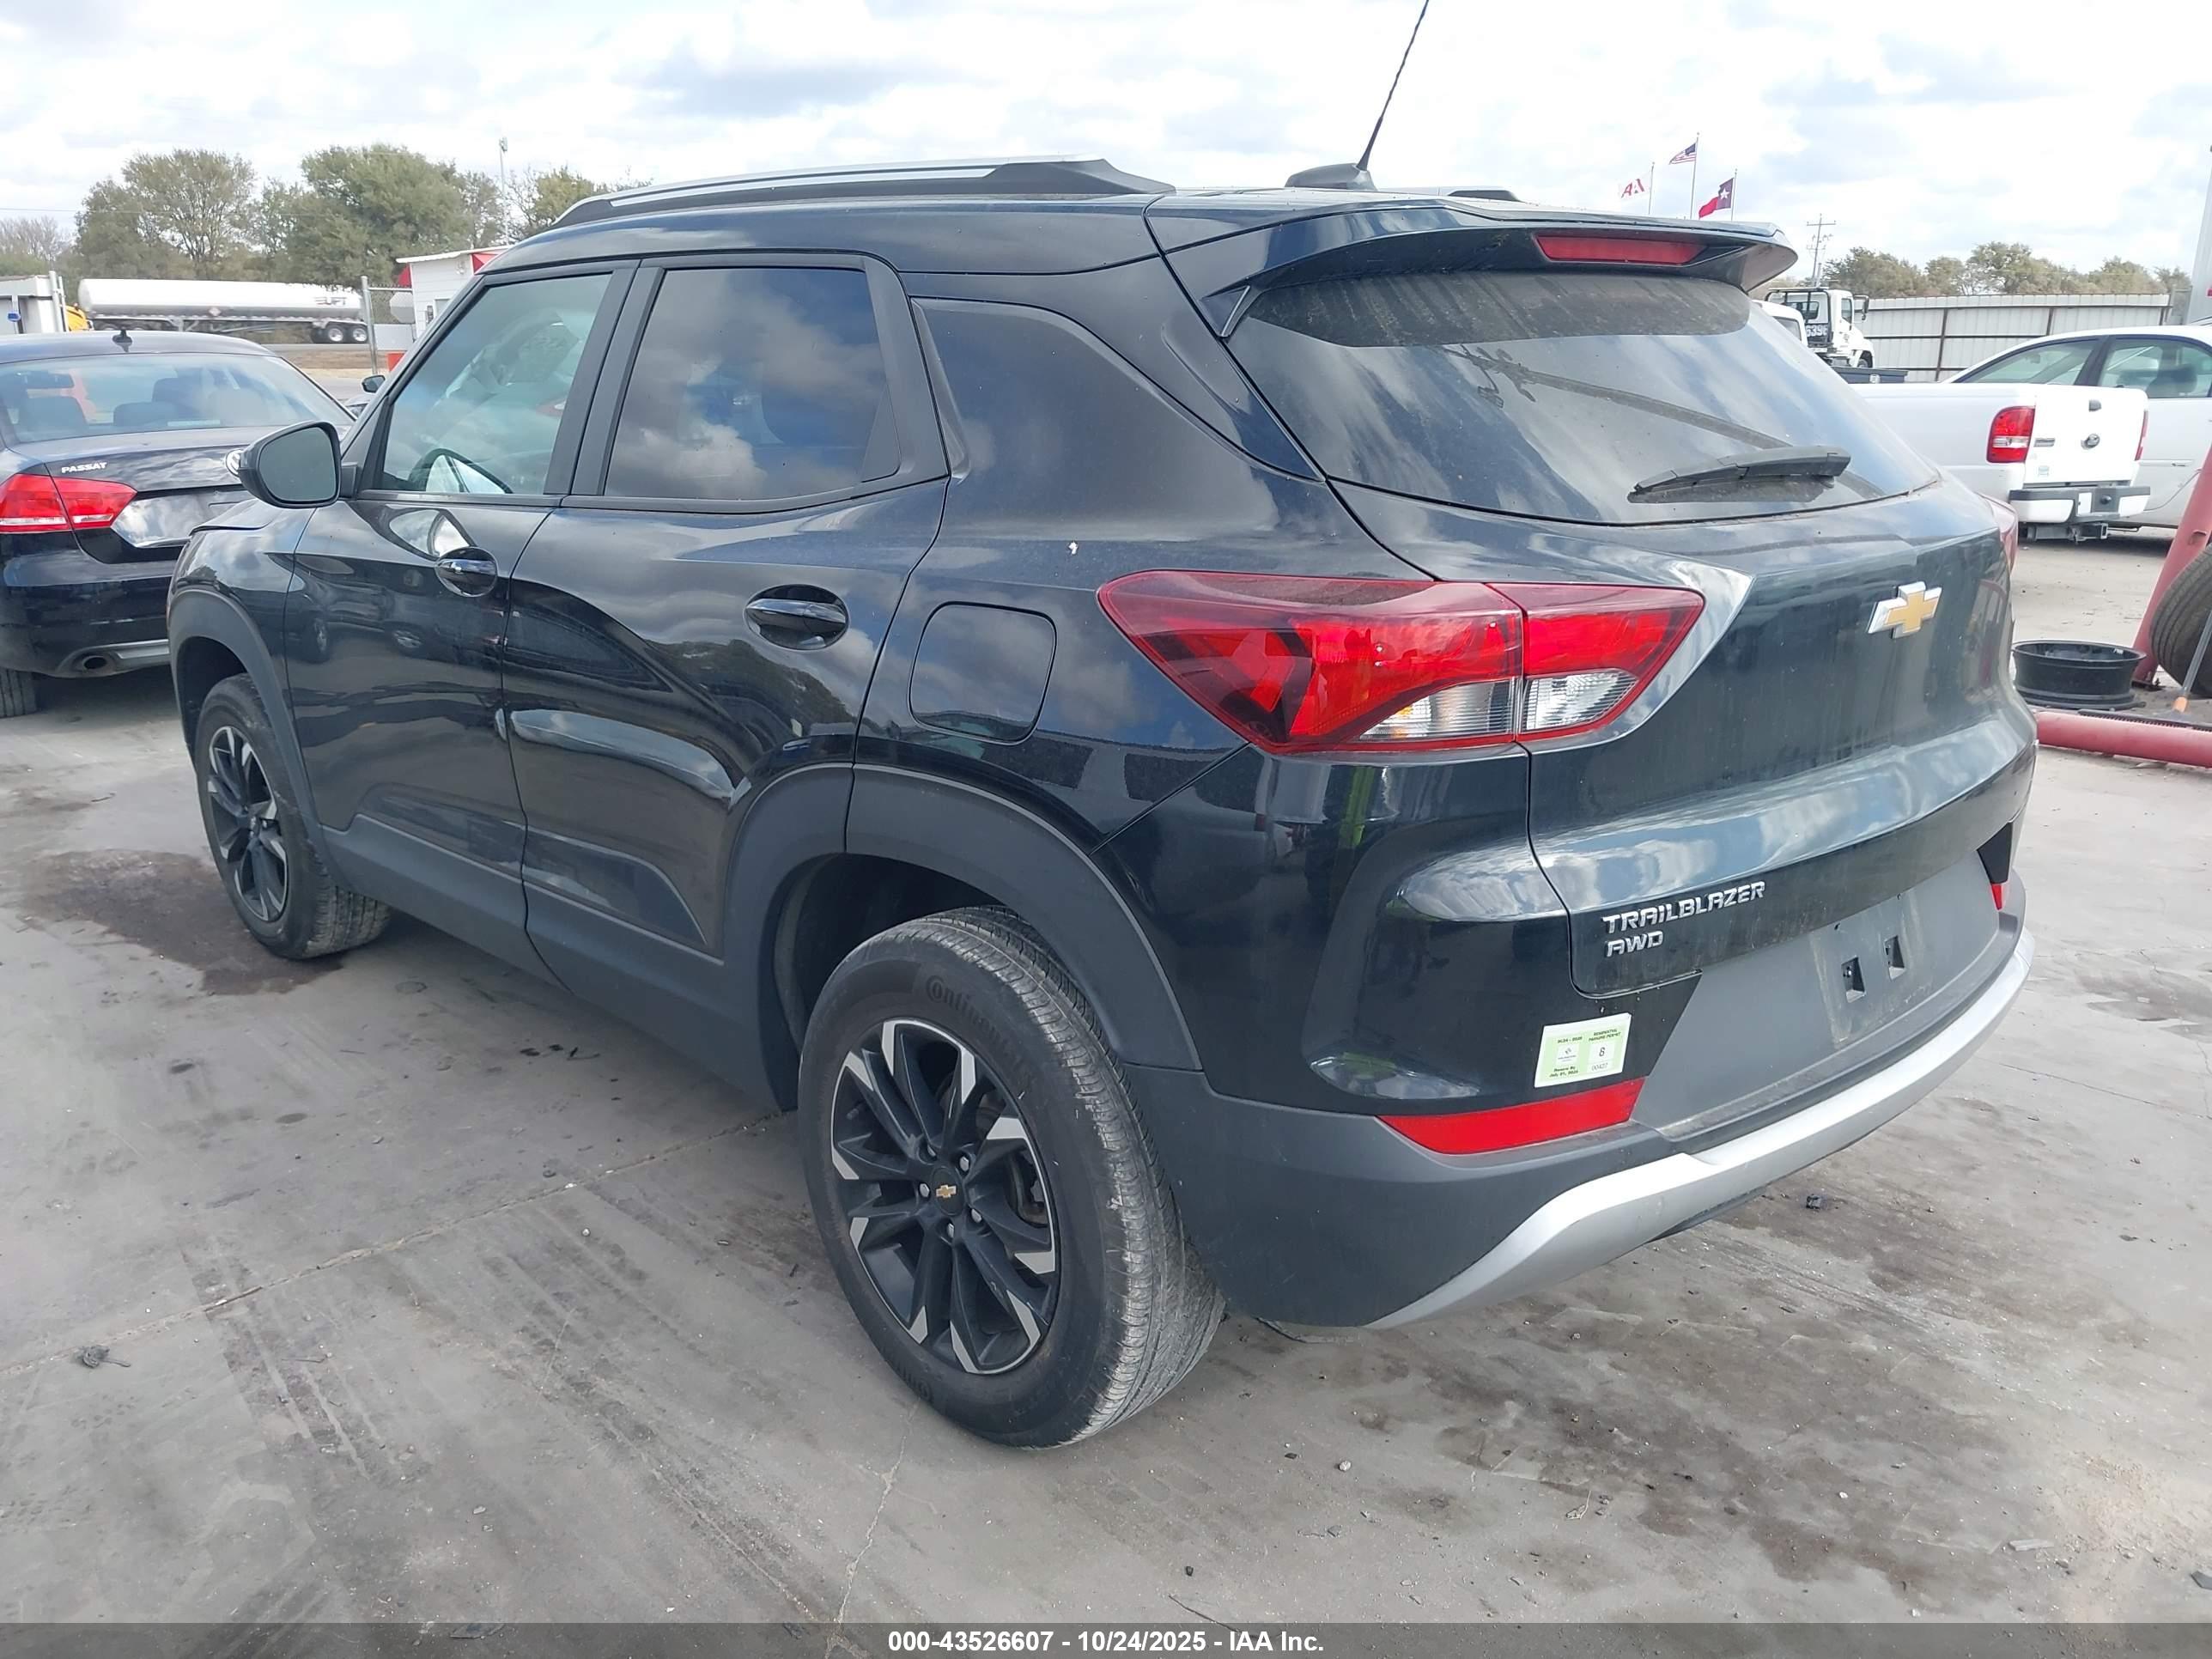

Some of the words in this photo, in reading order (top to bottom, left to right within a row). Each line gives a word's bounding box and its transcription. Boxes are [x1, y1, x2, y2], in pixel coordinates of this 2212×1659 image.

[61, 462, 107, 473] PASSAT
[1601, 881, 1765, 933] TRAILBLAZER
[1605, 930, 1663, 957] AWD
